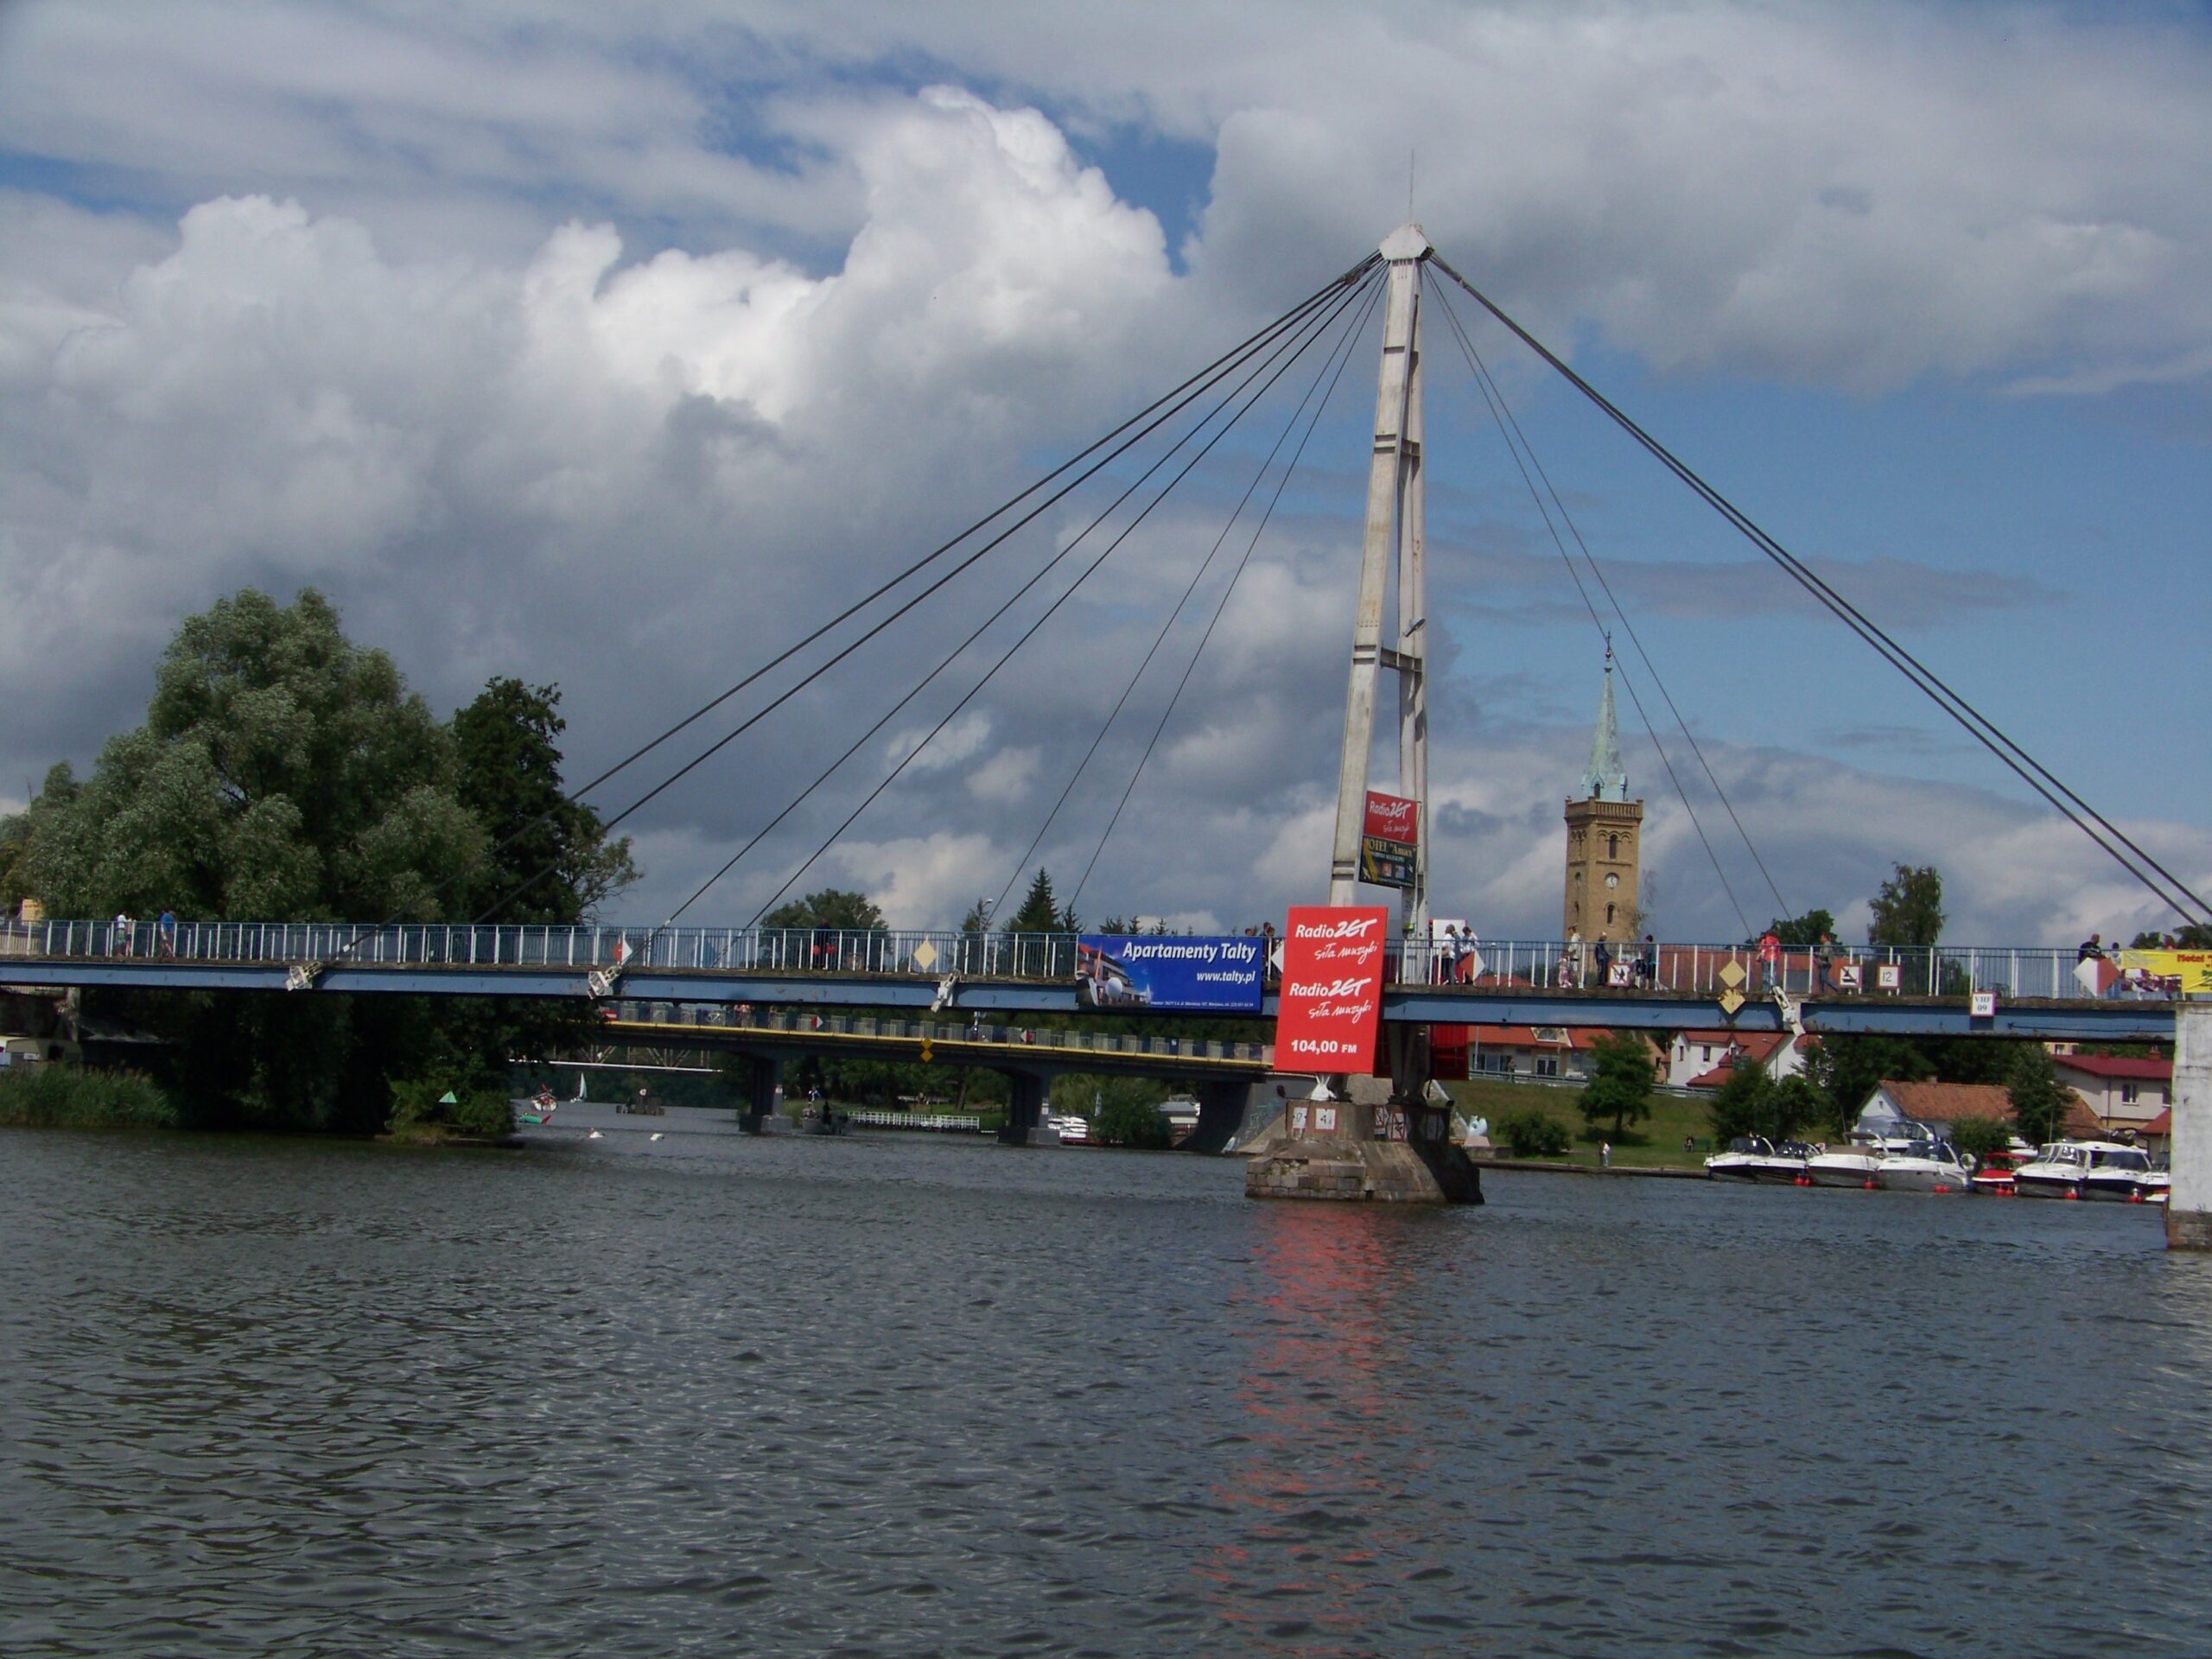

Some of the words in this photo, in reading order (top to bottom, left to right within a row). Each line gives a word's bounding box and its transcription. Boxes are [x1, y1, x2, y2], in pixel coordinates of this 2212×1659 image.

[1122, 941, 1217, 963] Apartamenty
[1221, 942, 1256, 963] Talty
[1197, 970, 1255, 984] www.talty.pl
[1291, 1039, 1338, 1055] 104,00
[1341, 1044, 1357, 1053] FM
